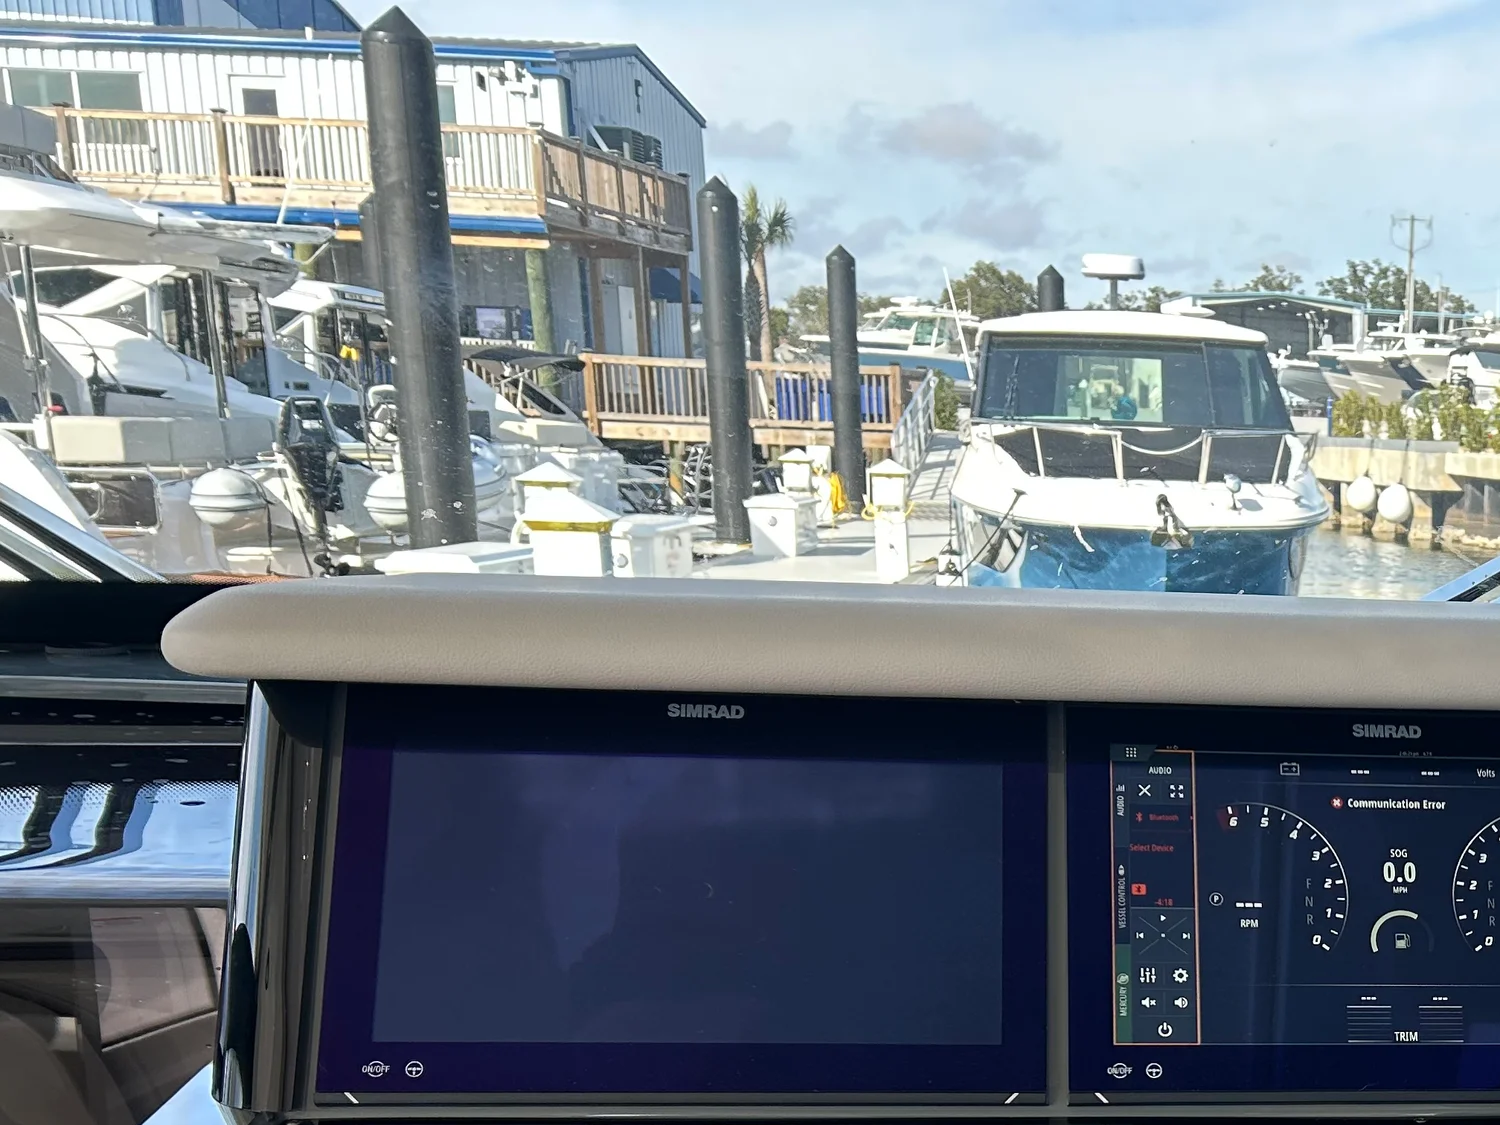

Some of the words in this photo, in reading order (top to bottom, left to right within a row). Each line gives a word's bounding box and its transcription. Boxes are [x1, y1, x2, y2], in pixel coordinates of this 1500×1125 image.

[667, 703, 745, 721] SIMRAD
[1353, 724, 1421, 738] SIMRAD
[1477, 769, 1495, 778] Volts
[1348, 799, 1420, 810] Communication
[1423, 800, 1446, 810] Error
[1390, 849, 1407, 858] SOG
[1383, 862, 1416, 883] 0.0
[1240, 919, 1258, 928] RPM
[1395, 1032, 1418, 1041] TRIM
[362, 1064, 390, 1074] ON/OFF
